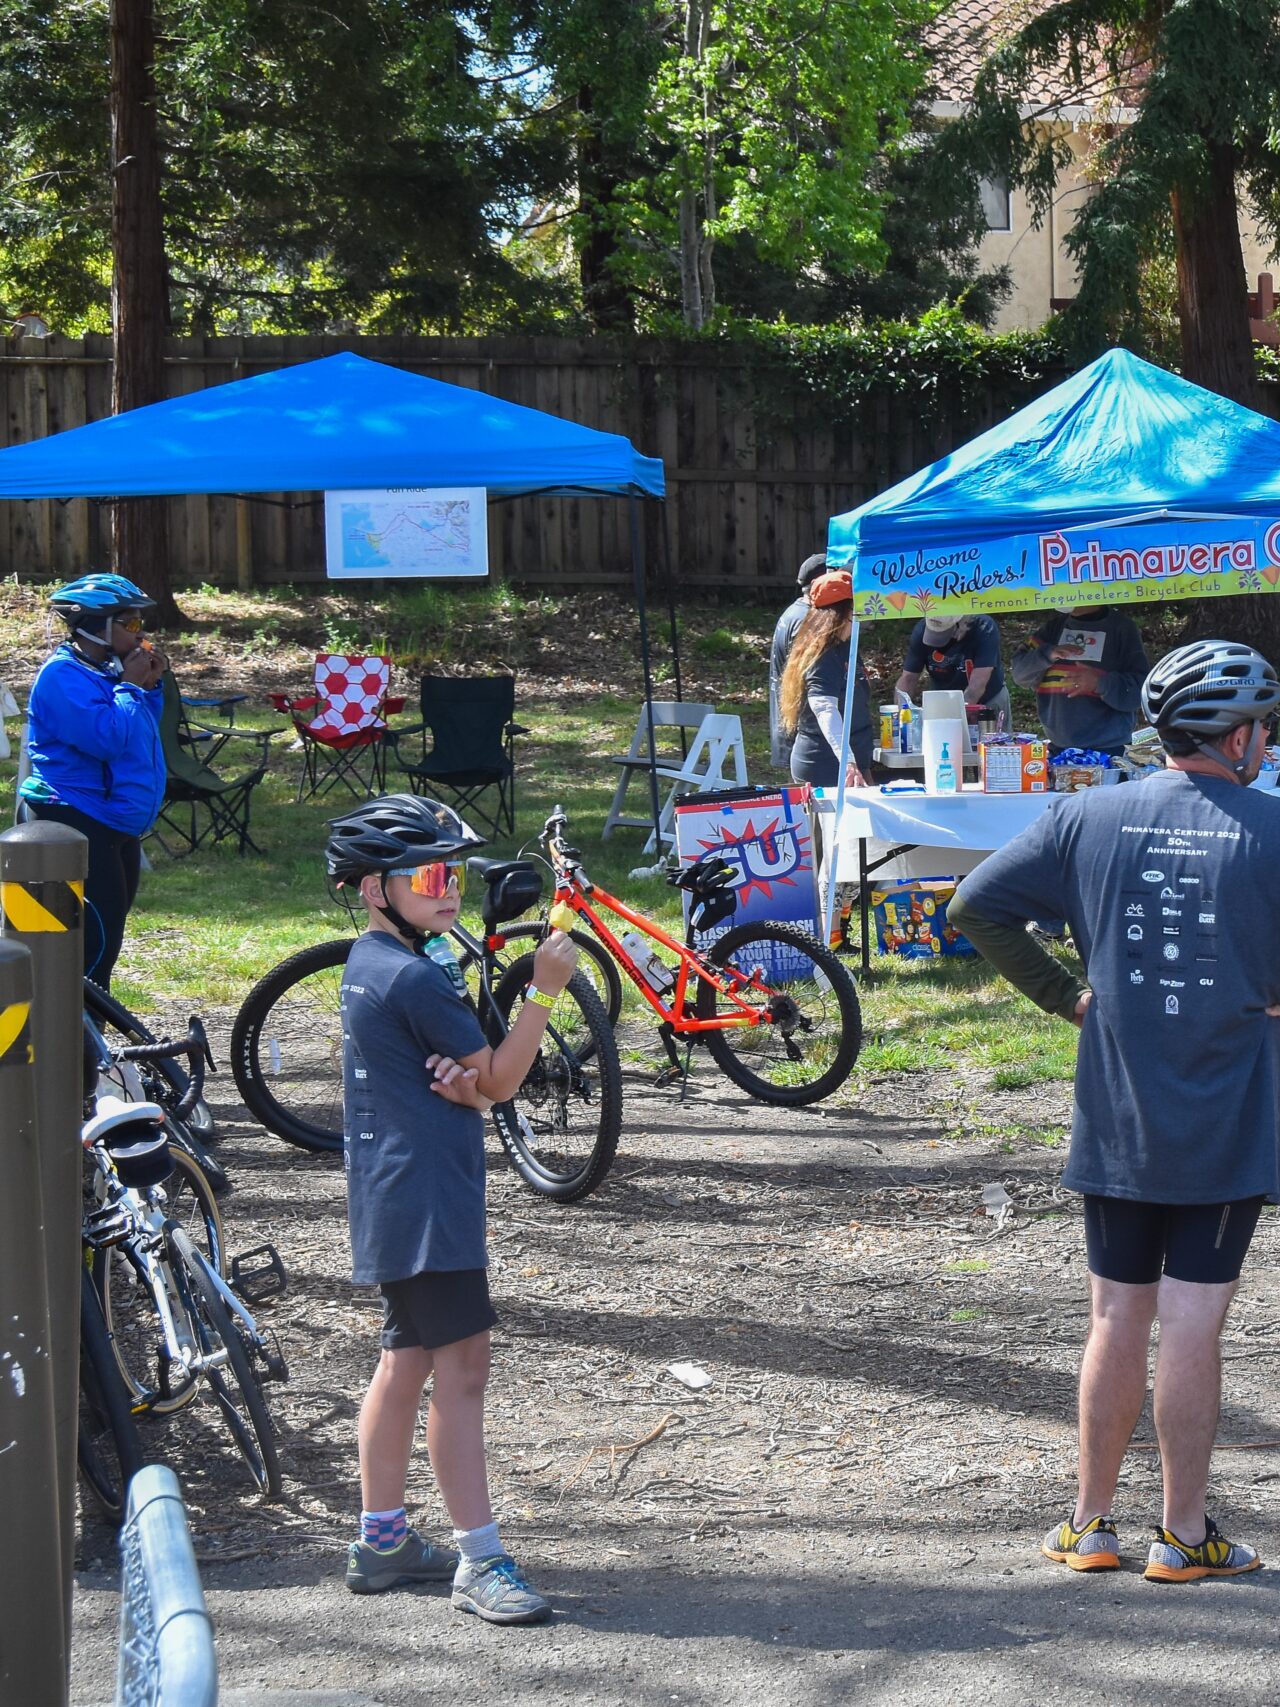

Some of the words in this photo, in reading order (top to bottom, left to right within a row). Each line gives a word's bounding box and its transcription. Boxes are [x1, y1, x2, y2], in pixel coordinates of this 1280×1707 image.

[871, 547, 982, 587] Welcome
[934, 550, 1028, 600] Riders!
[1038, 534, 1255, 586] Primavera
[971, 597, 1029, 609] Fremont
[1136, 585, 1185, 600] Bicycle
[1190, 578, 1221, 592] Club
[1229, 678, 1255, 686] GIRO
[1216, 831, 1241, 840] 2022
[350, 985, 365, 994] 2022
[1199, 978, 1214, 986] GU
[243, 1025, 255, 1079] MAXXIS
[360, 1132, 374, 1140] GU
[496, 1112, 526, 1164] MAXXIS
